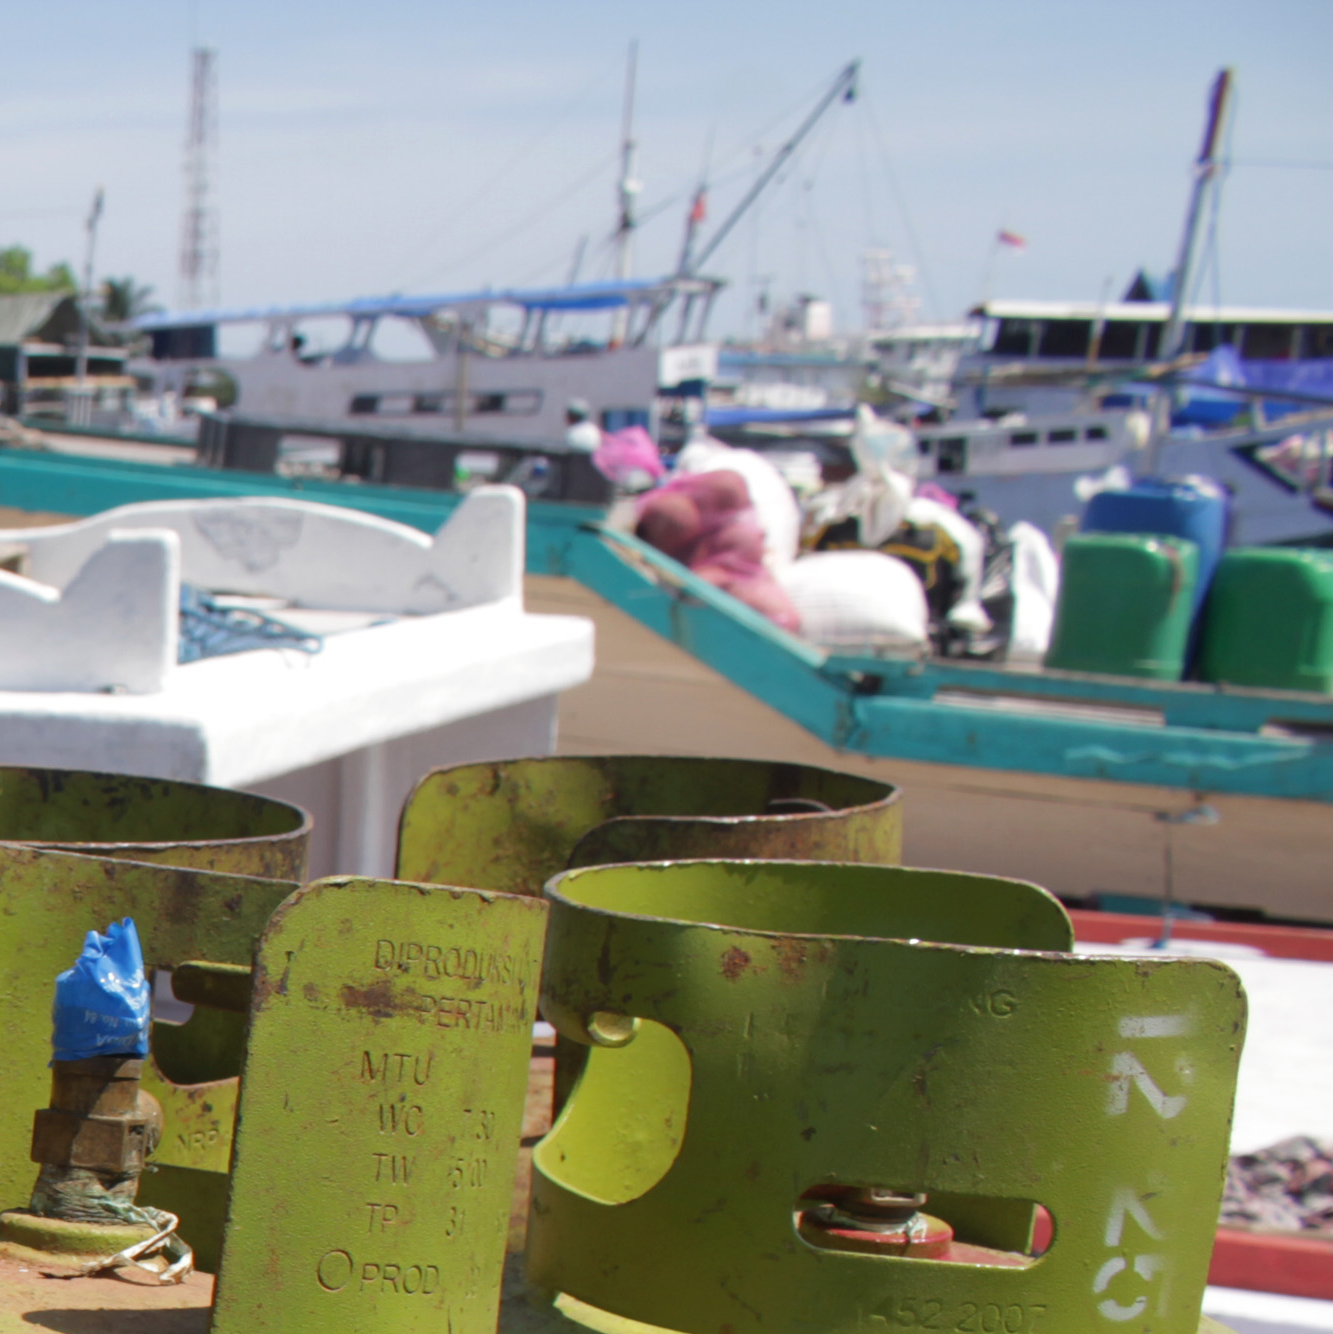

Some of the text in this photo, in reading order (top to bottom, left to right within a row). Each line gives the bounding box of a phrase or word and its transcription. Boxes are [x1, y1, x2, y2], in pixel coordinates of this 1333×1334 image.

[360, 1050, 434, 1087] MTU
[379, 1102, 425, 1137] WC
[364, 1201, 401, 1235] TP
[359, 1263, 441, 1297] PROD
